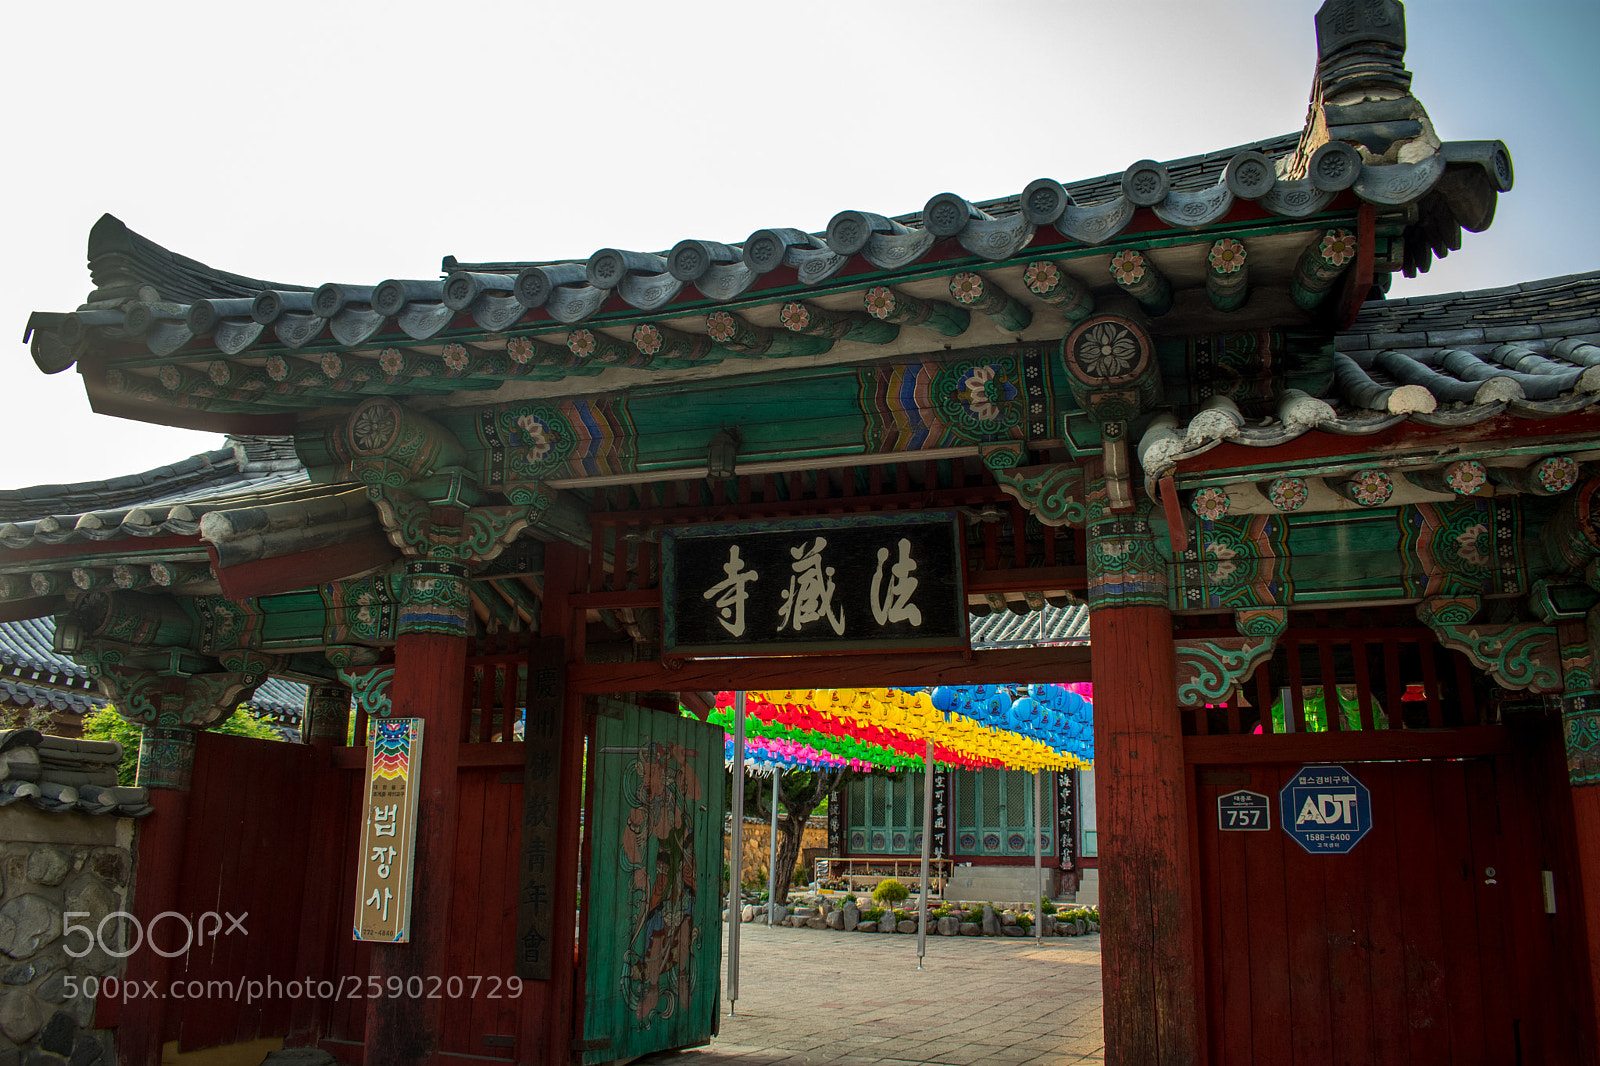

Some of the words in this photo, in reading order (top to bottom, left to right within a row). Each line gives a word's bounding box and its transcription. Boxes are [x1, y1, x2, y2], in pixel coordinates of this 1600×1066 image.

[1227, 810, 1260, 826] 757
[1296, 794, 1357, 824] ADT
[1305, 833, 1351, 841] 1588-6400
[366, 804, 397, 922] 법장사
